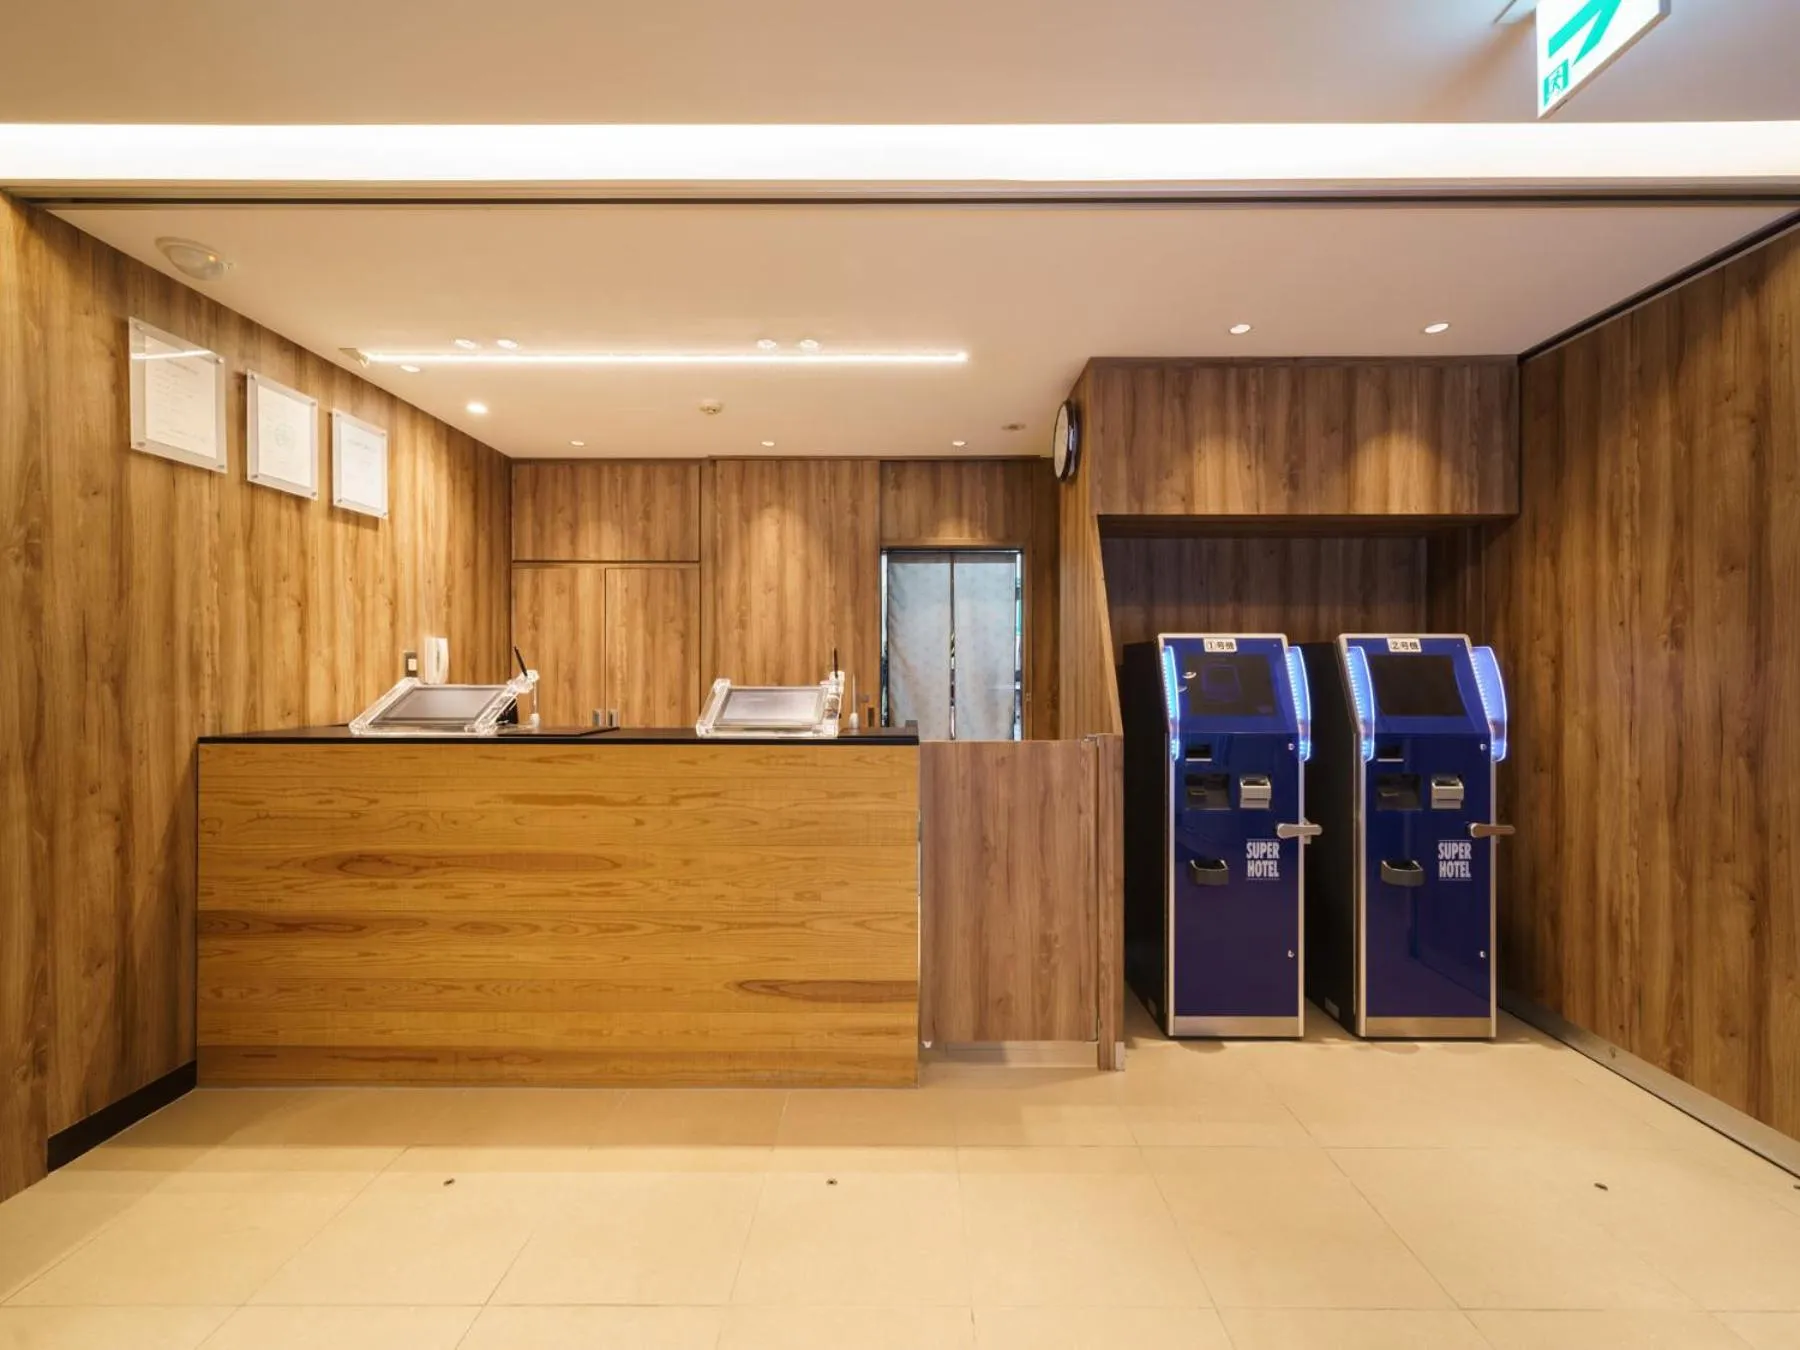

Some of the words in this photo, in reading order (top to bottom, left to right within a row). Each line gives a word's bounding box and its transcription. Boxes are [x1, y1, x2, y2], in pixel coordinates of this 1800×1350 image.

[1246, 842, 1280, 859] SUPER
[1438, 842, 1472, 860] SUPER
[1247, 860, 1280, 878] HOTEL
[1439, 860, 1472, 878] HOTEL
